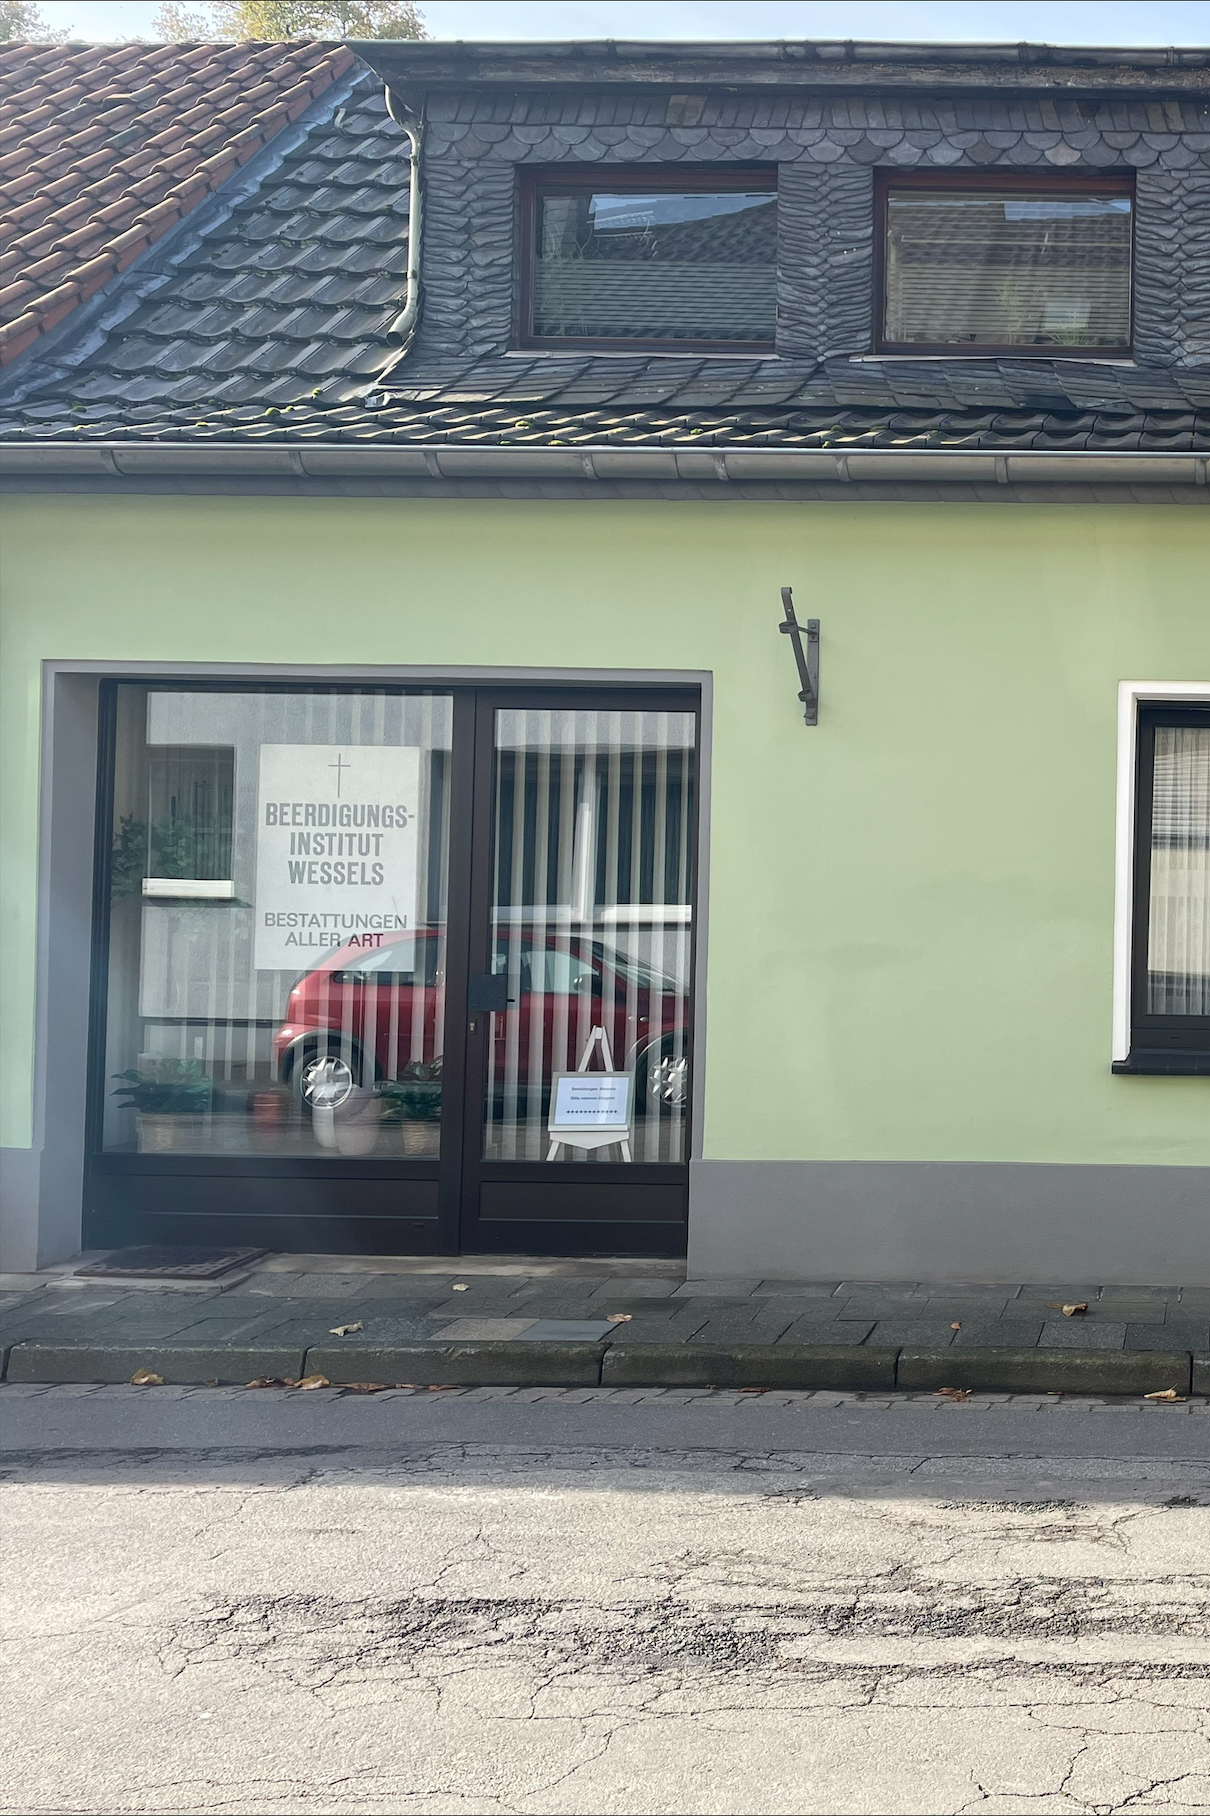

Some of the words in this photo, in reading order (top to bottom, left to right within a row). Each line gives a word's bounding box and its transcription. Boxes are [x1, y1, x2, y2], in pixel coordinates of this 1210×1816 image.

[265, 802, 415, 829] BEERDIGUNGS-
[289, 832, 384, 857] INSTITUT
[287, 860, 384, 886] WESSELS
[264, 912, 408, 929] BESTATTUNGEN
[285, 931, 342, 948] ALLER
[347, 933, 384, 948] ART
